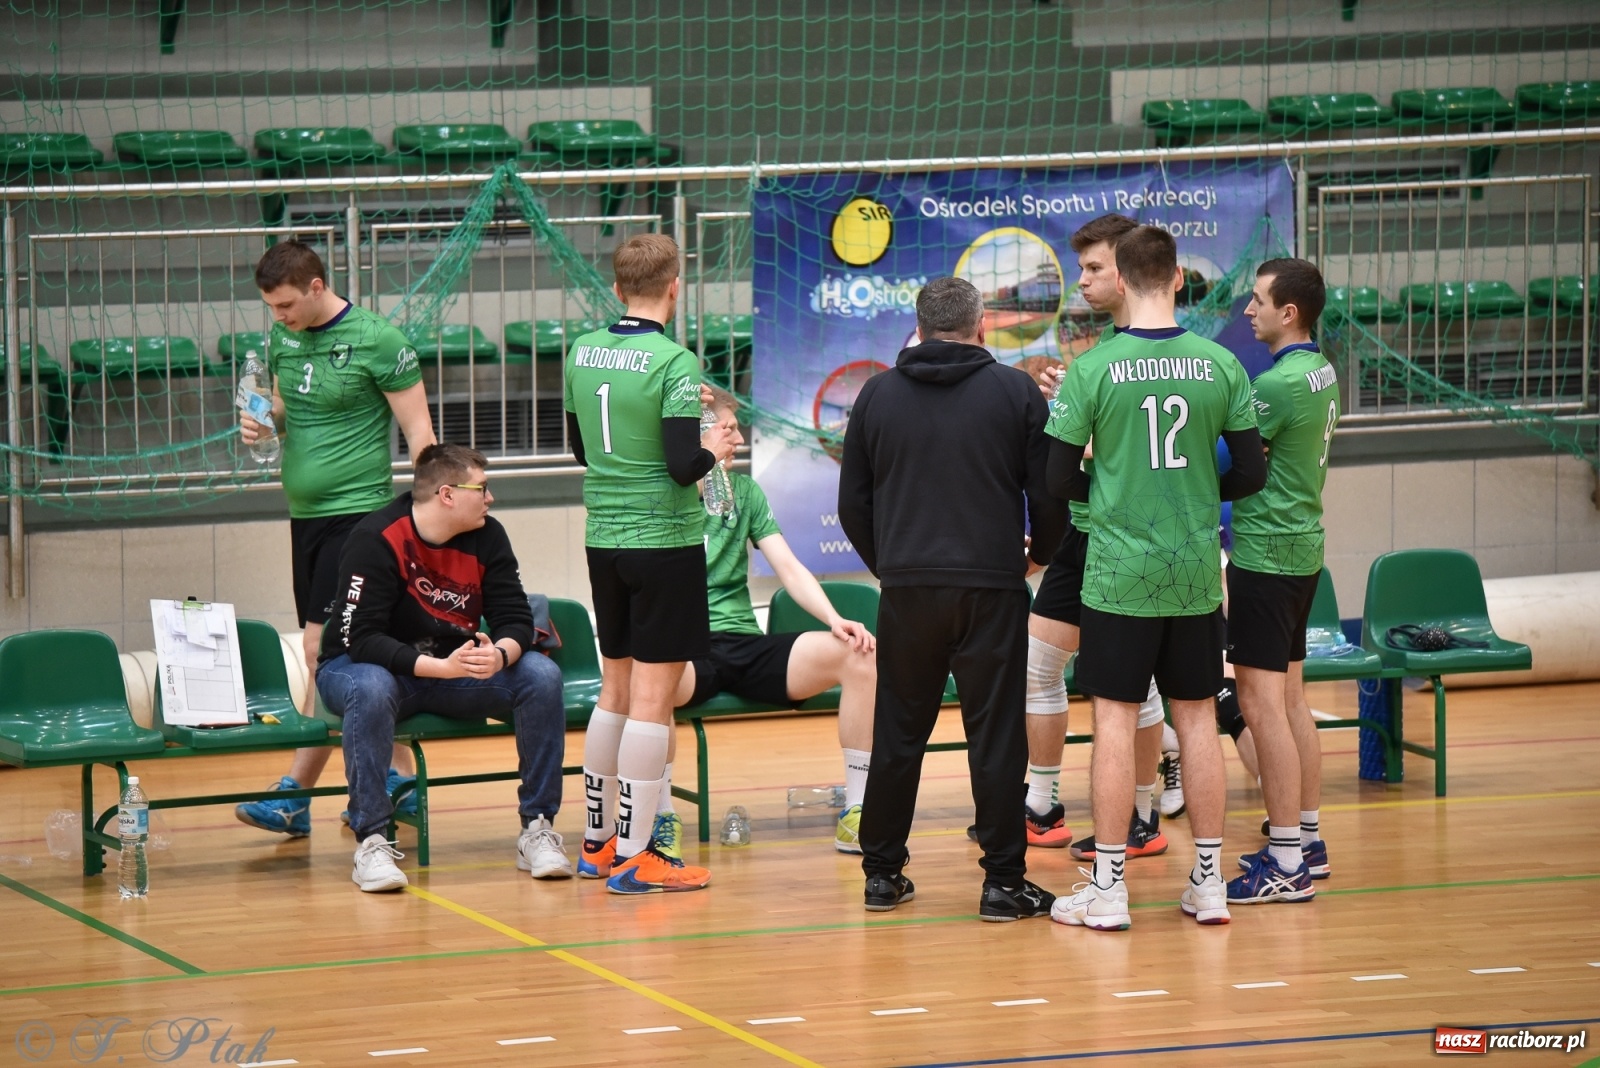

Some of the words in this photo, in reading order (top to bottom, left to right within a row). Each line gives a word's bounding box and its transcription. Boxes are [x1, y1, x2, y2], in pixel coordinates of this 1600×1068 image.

[920, 195, 1017, 217] Ośrodek
[1022, 193, 1095, 219] Sportu
[1101, 191, 1108, 211] i
[1114, 186, 1217, 210] Rekreacji
[575, 345, 654, 373] WŁODOWICE
[1108, 357, 1214, 384] WŁODOWICE
[298, 362, 313, 394] 3
[594, 381, 612, 454] 1
[1139, 393, 1190, 470] 12
[1319, 398, 1336, 468] 9
[415, 576, 471, 614] GARRIX
